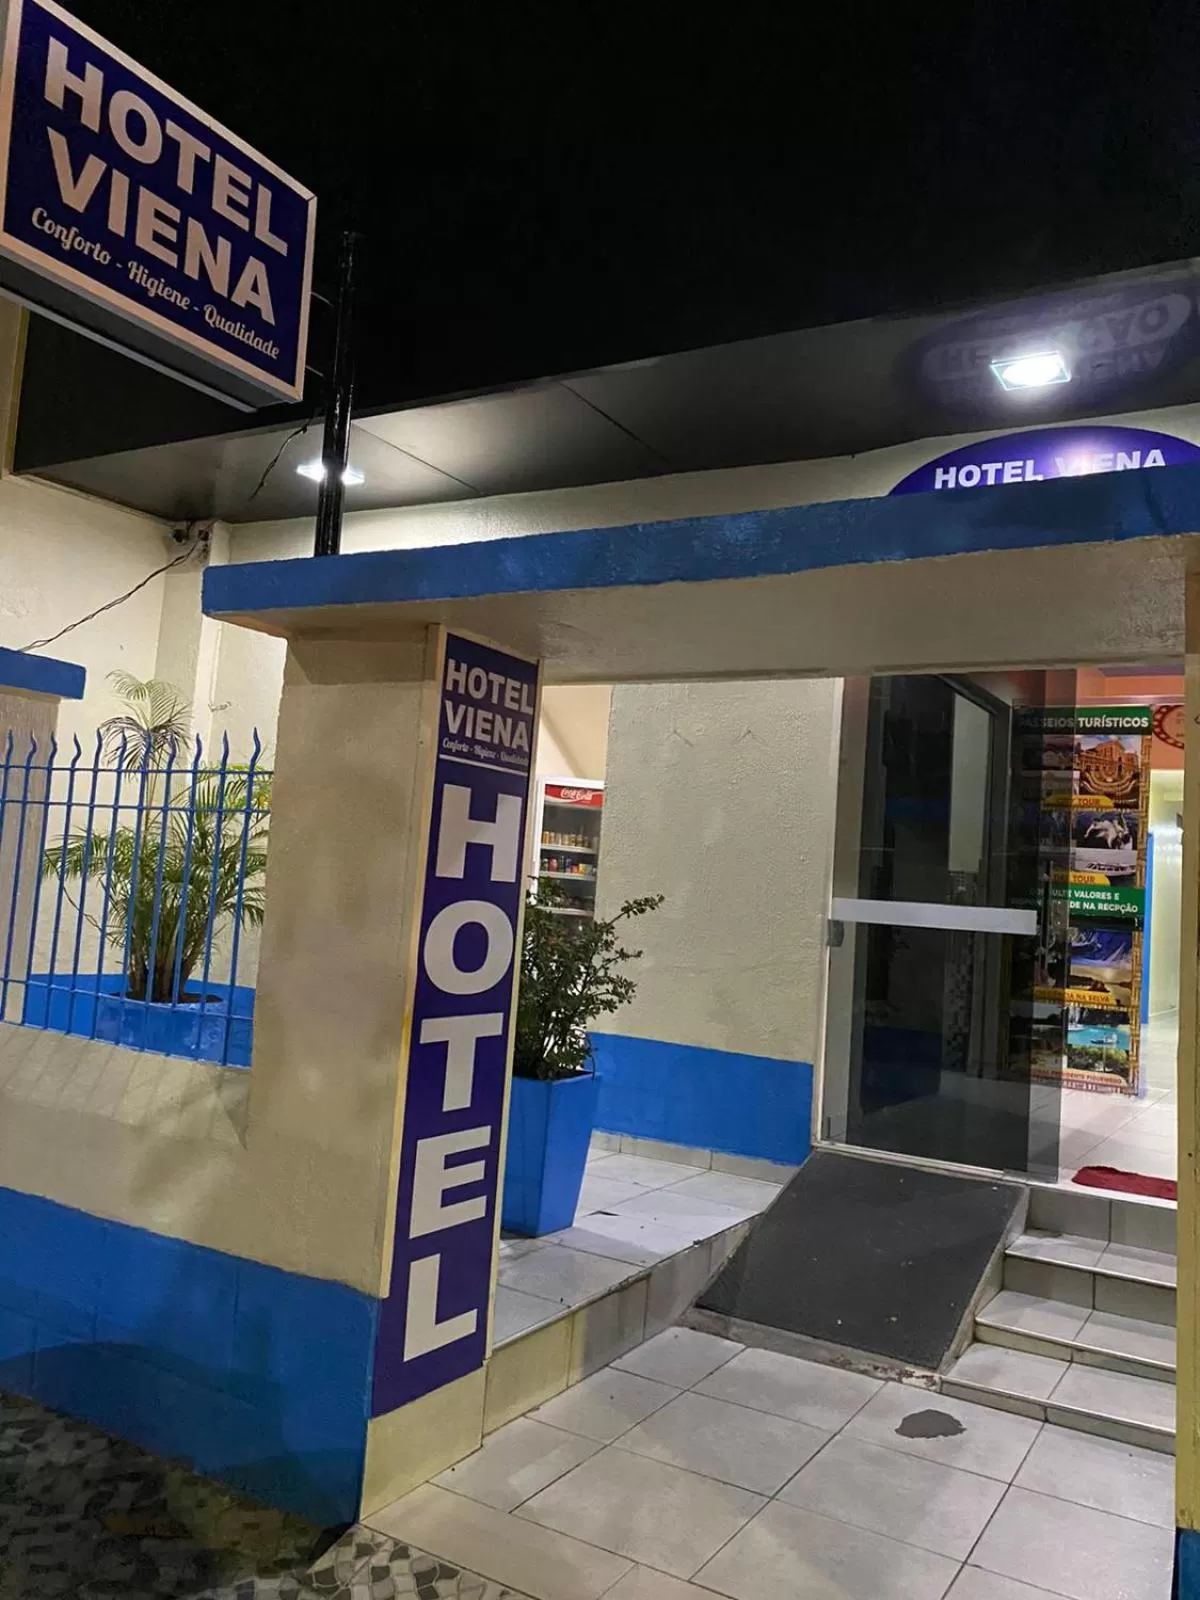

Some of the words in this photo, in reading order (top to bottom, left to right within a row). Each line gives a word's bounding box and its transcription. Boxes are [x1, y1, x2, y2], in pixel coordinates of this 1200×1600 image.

[44, 36, 289, 257] HOTEL
[47, 127, 276, 326] VIENA
[31, 207, 111, 265] Conforto
[128, 259, 191, 311] Higiene
[203, 304, 280, 360] Qualidade
[934, 459, 1044, 490] HOTEL
[1055, 449, 1166, 477] VENA
[446, 658, 533, 716] HOTEL
[445, 700, 530, 753] VIENA
[1078, 714, 1149, 728] TURÍSTICOS
[1071, 874, 1096, 884] TOUR
[1074, 889, 1112, 901] VALORES
[1114, 892, 1120, 901] E
[1083, 902, 1096, 911] NA
[403, 784, 522, 1362] HOTEL
